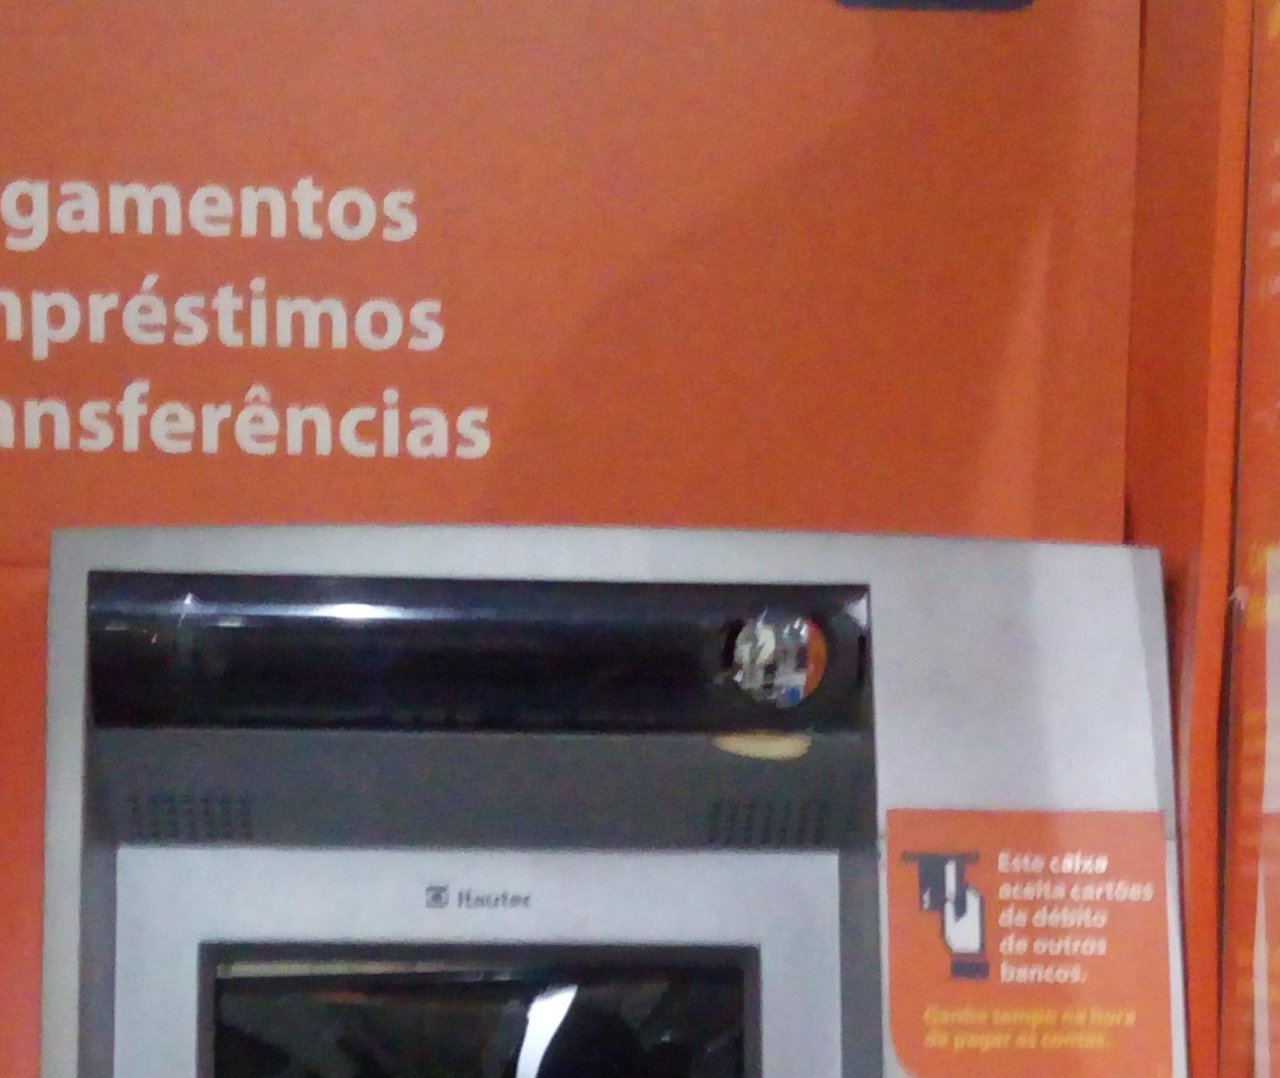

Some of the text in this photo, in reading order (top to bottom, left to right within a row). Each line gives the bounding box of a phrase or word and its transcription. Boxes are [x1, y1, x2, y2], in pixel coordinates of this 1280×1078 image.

[998, 904, 1109, 928] de débito
[999, 933, 1108, 956] de outros
